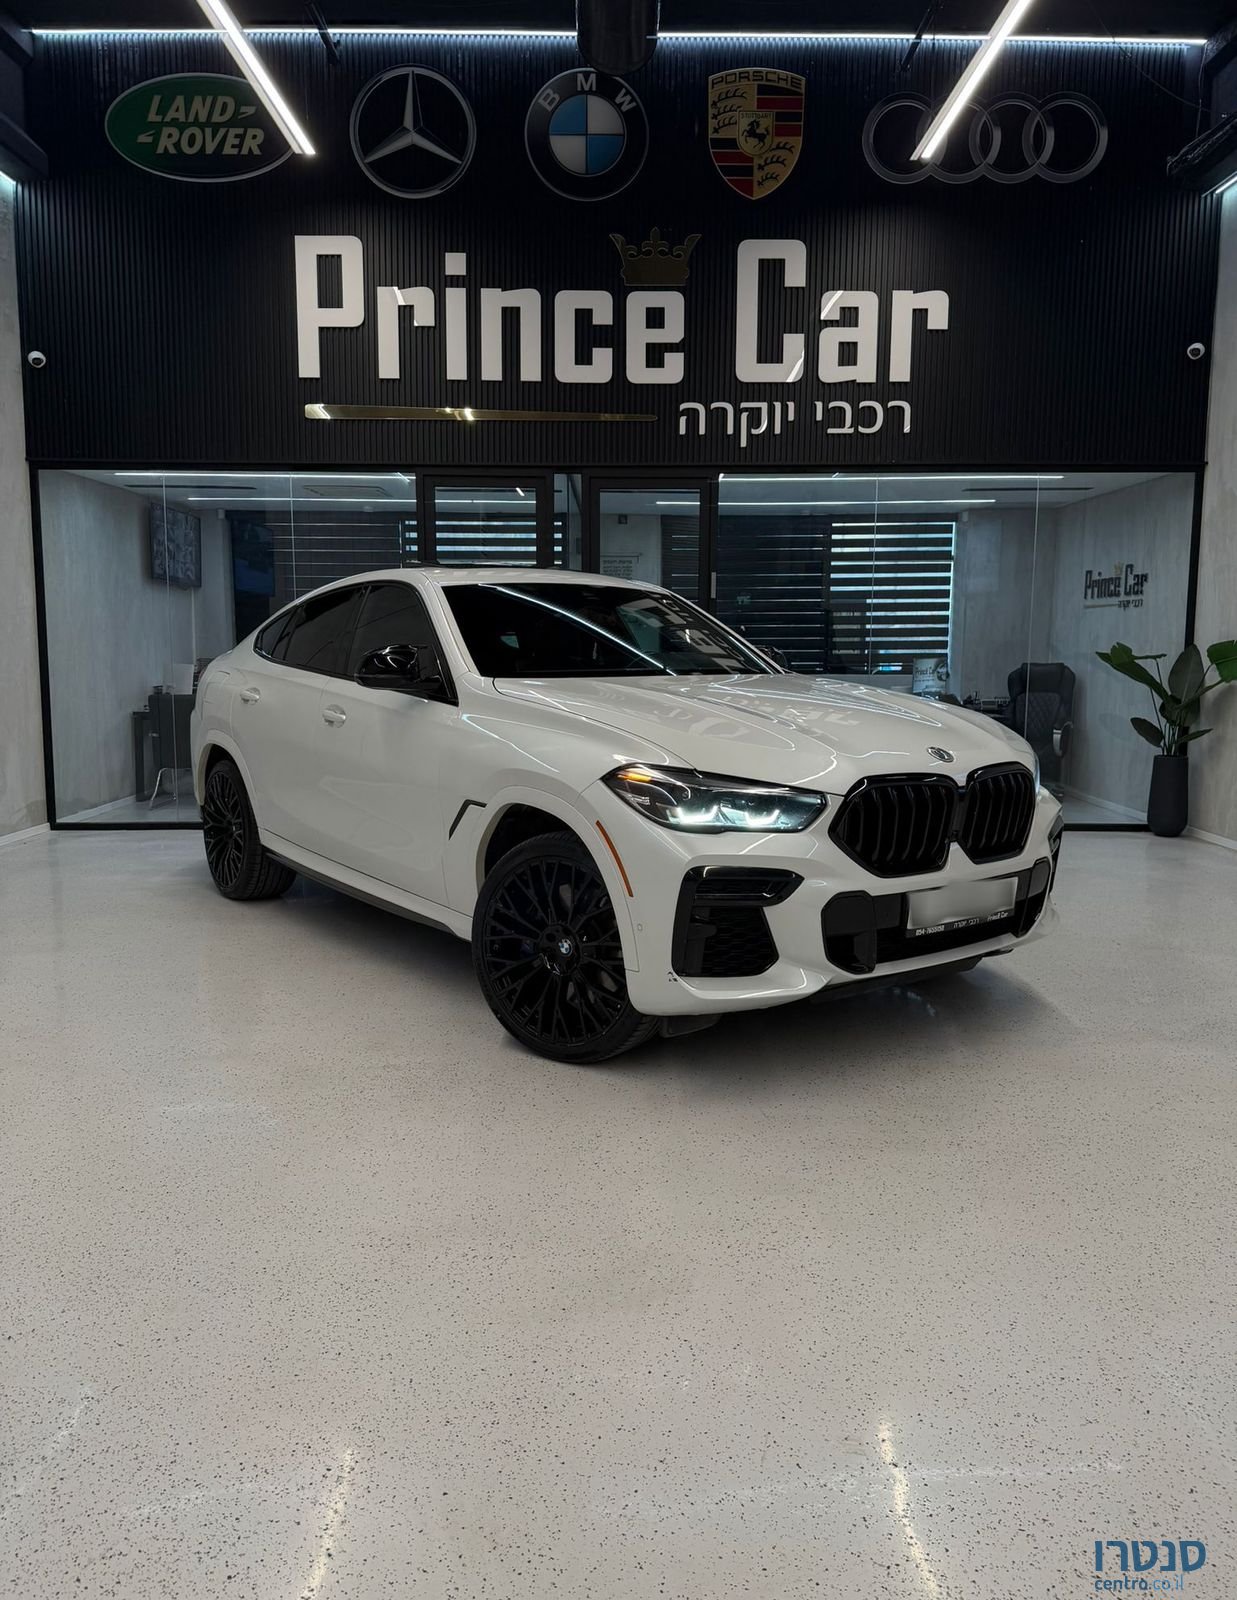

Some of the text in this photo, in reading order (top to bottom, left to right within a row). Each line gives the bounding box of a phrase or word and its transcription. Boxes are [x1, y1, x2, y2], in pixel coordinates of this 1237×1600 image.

[538, 72, 637, 113] BMW
[711, 70, 803, 90] PORSCHE
[147, 95, 236, 123] LAND
[155, 126, 265, 156] ROVER
[294, 234, 949, 385] Prince Car
[679, 400, 912, 448] רכבי יוקרה
[1083, 564, 1148, 600] Prince Car
